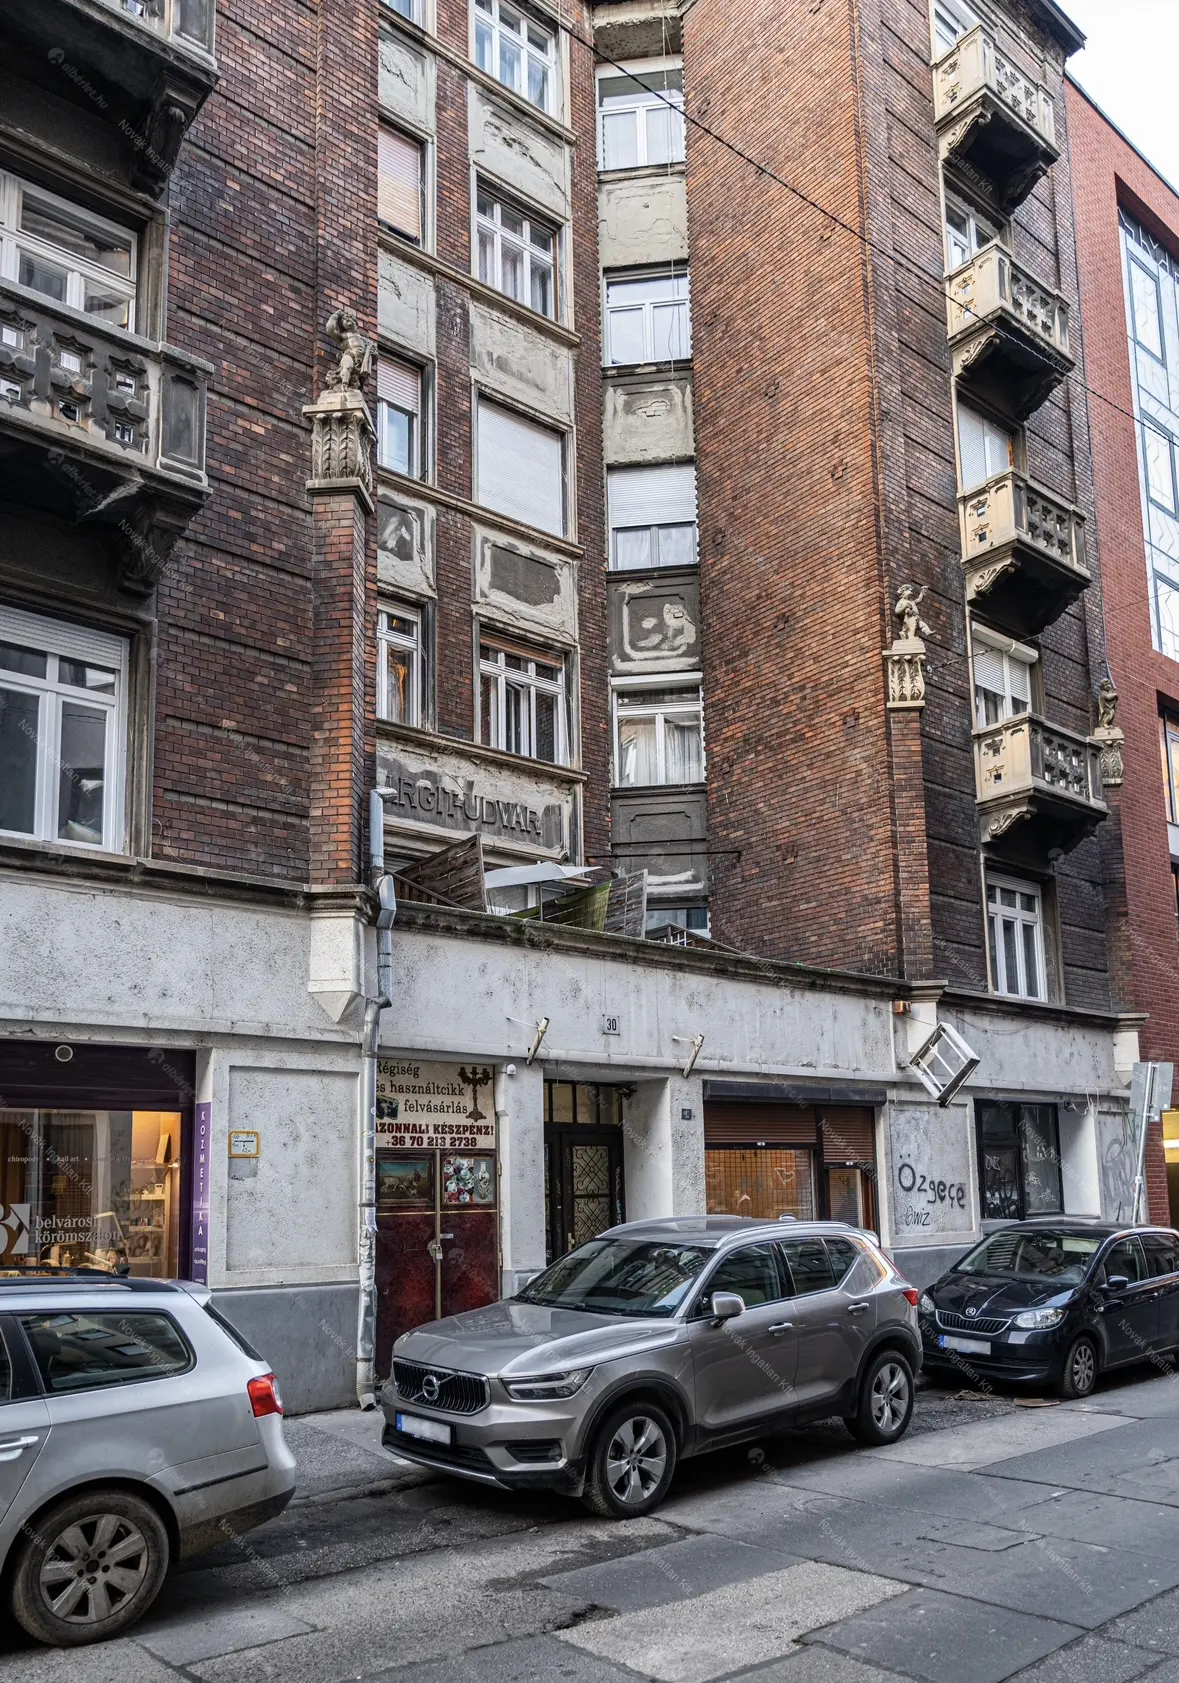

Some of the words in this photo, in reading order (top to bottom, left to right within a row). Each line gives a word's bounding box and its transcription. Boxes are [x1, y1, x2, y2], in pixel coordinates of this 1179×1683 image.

[606, 1018, 617, 1031] 30
[376, 1061, 419, 1078] Régiség
[390, 1080, 464, 1096] használtcikk
[404, 1099, 468, 1114] felvásárlás
[433, 1121, 494, 1136] KÉSZPÉNZ!
[385, 1135, 406, 1147] +36
[409, 1136, 423, 1147] 70
[427, 1136, 446, 1147] 213
[449, 1137, 477, 1147] 2738
[35, 1215, 98, 1229] belvárosi
[34, 1230, 120, 1244] körömszalon
